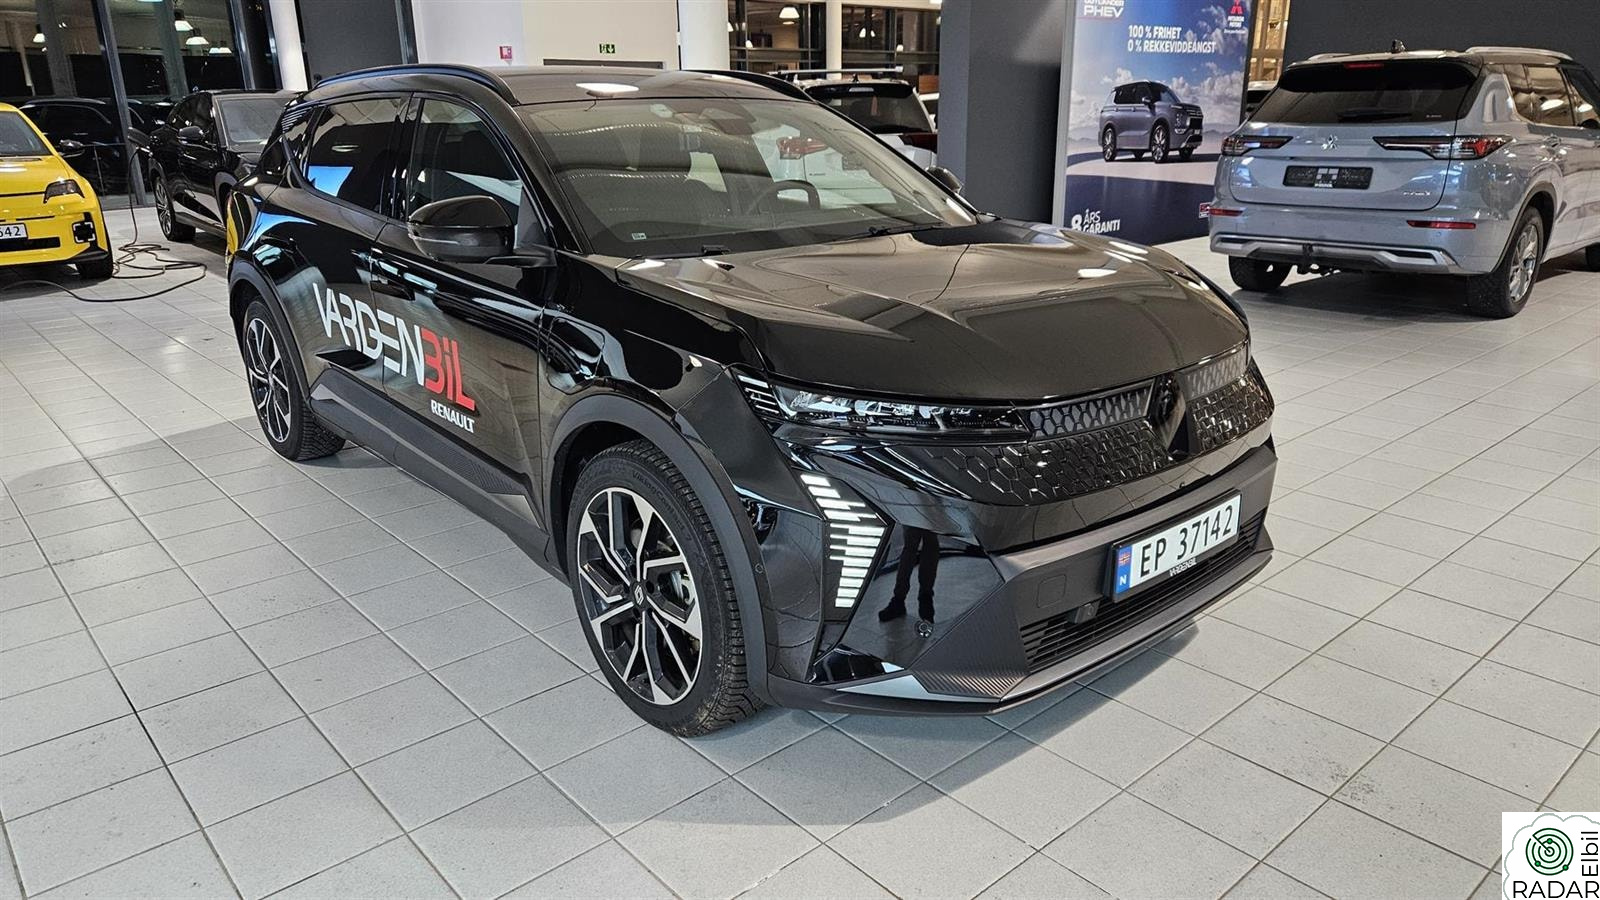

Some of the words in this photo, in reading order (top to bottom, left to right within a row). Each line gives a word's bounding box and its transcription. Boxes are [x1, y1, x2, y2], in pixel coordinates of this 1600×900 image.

[1083, 5, 1124, 17] PHEV
[1128, 25, 1144, 38] 100
[1145, 26, 1152, 39] %
[1153, 26, 1182, 39] FRIHET
[1127, 39, 1134, 52] 0
[1135, 39, 1142, 52] %
[1071, 214, 1083, 231] 8
[1083, 209, 1101, 225] ÅRS
[1083, 219, 1121, 233] GARANTI
[430, 400, 475, 433] RENAULT
[1140, 538, 1167, 577] EP
[1177, 505, 1233, 560] 37142
[1120, 575, 1127, 585] N
